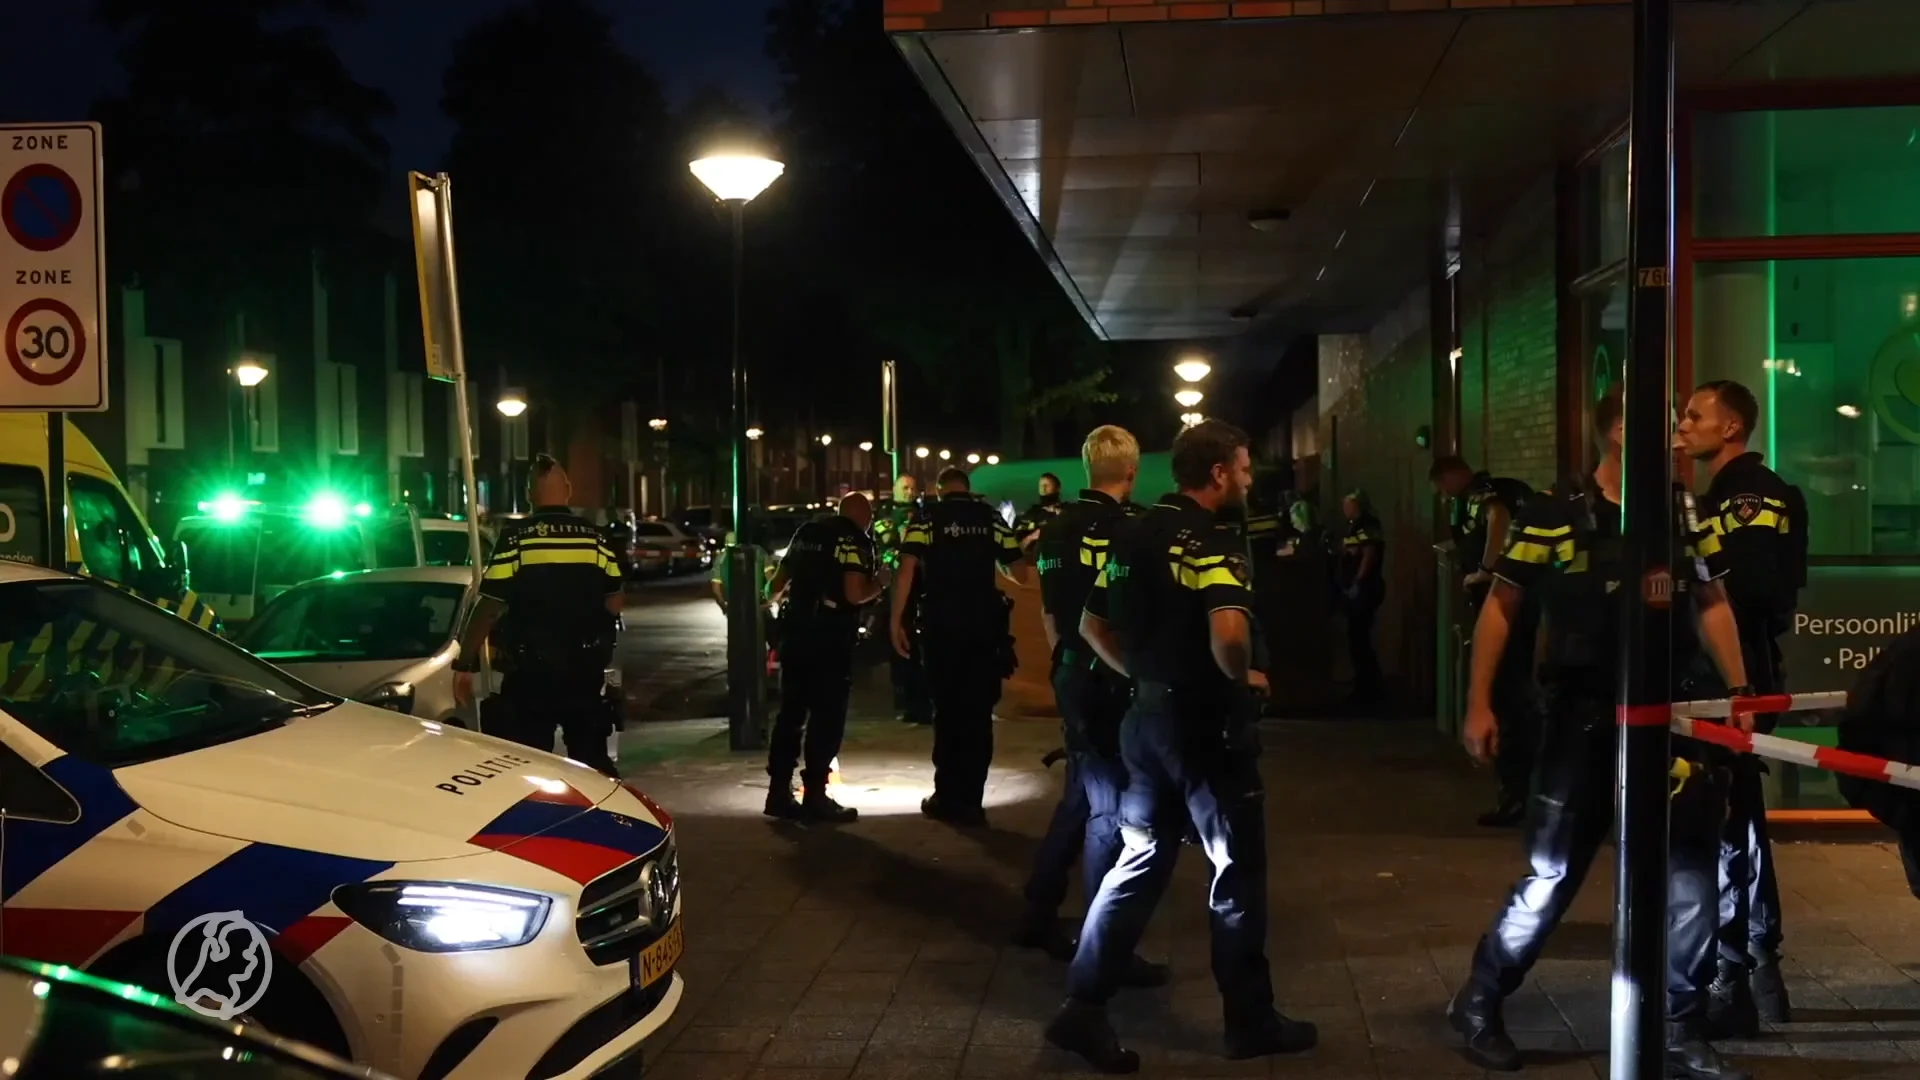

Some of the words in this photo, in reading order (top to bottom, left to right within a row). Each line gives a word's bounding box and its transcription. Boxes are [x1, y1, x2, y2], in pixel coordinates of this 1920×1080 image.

[12, 135, 69, 150] ZONE
[16, 270, 72, 284] ZONE
[21, 326, 69, 359] 30
[1794, 611, 1920, 636] Persoonlij
[436, 755, 531, 795] POLITIE
